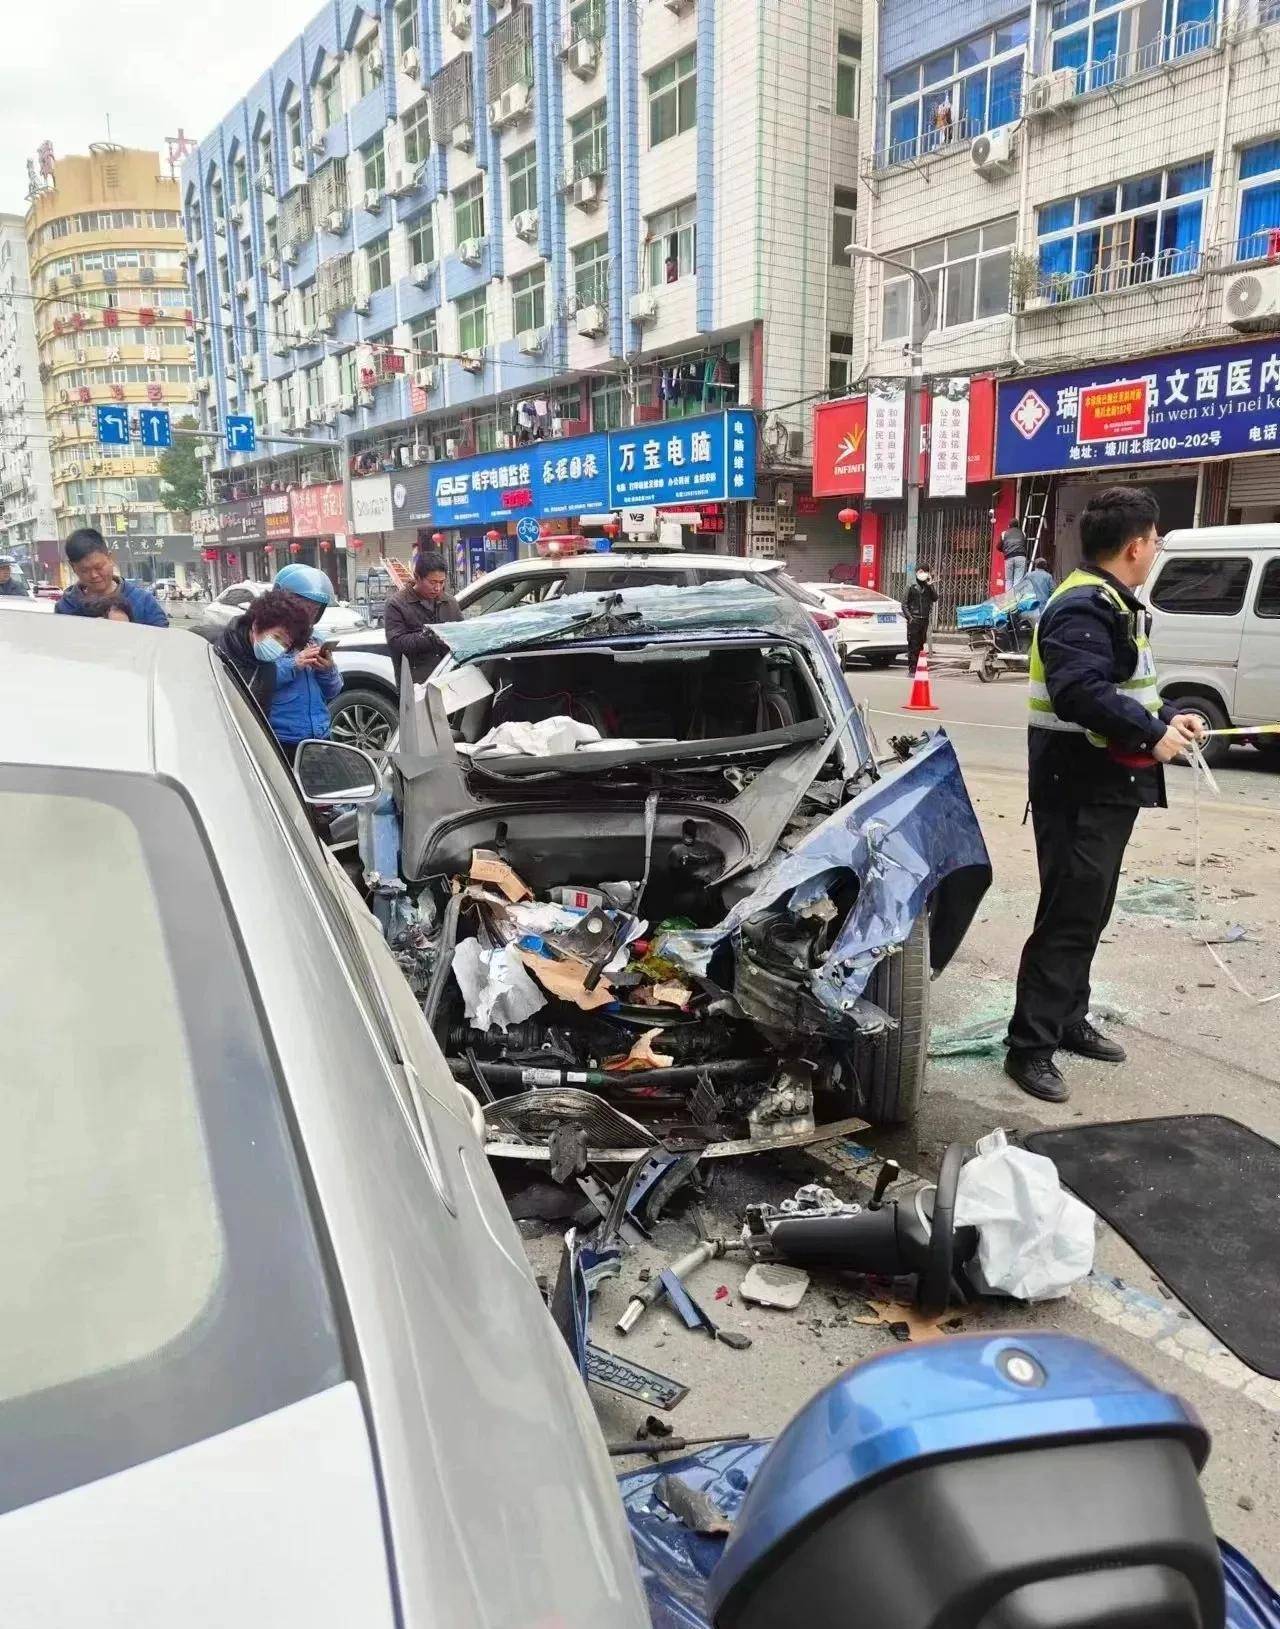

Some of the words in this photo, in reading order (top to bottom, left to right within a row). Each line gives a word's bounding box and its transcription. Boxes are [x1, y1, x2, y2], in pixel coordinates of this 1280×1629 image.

[1056, 421, 1075, 435] rui
[1168, 407, 1198, 422] wen
[1201, 402, 1215, 418] xi
[1218, 399, 1233, 420] yi
[1237, 396, 1262, 413] nei
[619, 430, 711, 472] 万宝电脑
[733, 421, 744, 488] 电脑维修
